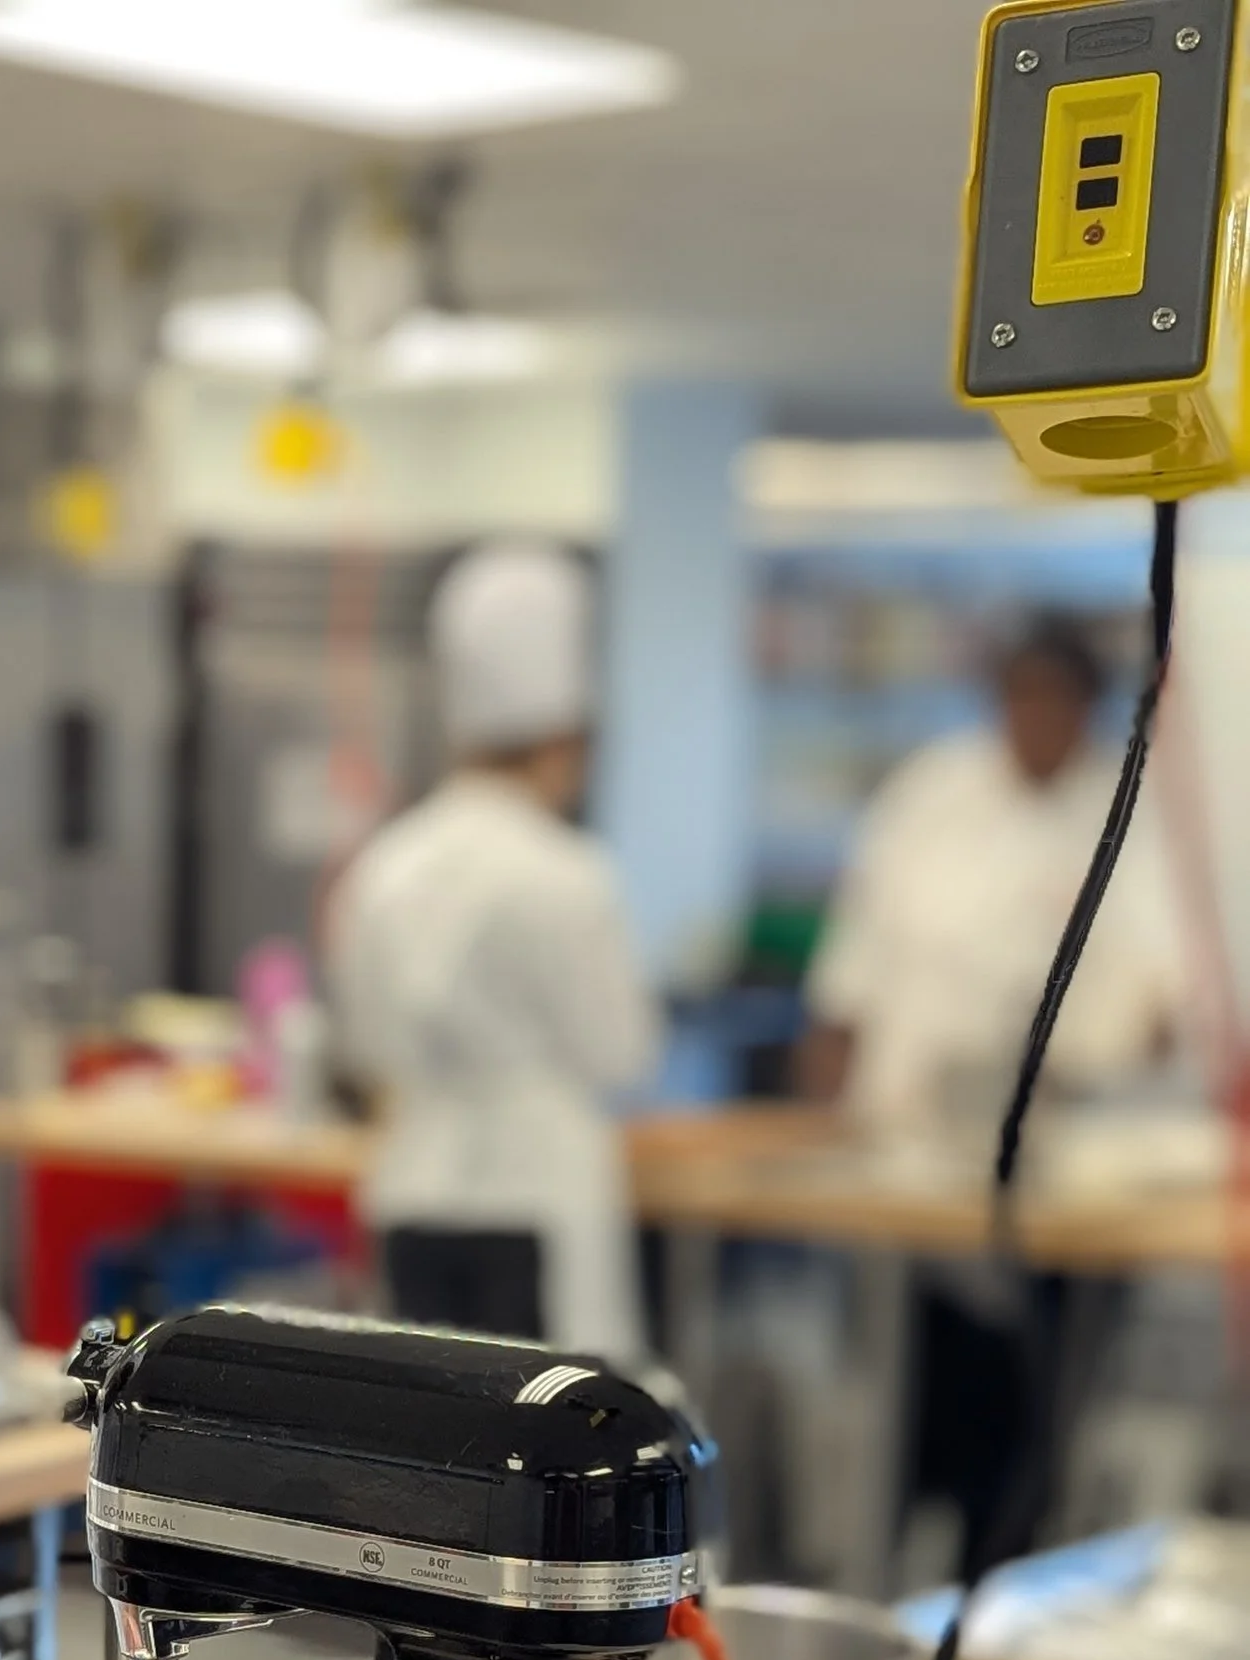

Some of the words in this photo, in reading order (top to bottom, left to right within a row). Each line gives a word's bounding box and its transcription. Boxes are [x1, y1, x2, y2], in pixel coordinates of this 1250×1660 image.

[103, 1503, 176, 1530] COMMERCIAL
[429, 1557, 435, 1566] 8
[437, 1558, 451, 1569] QT
[410, 1568, 468, 1585] COMMERCIAL
[560, 1577, 584, 1585] before
